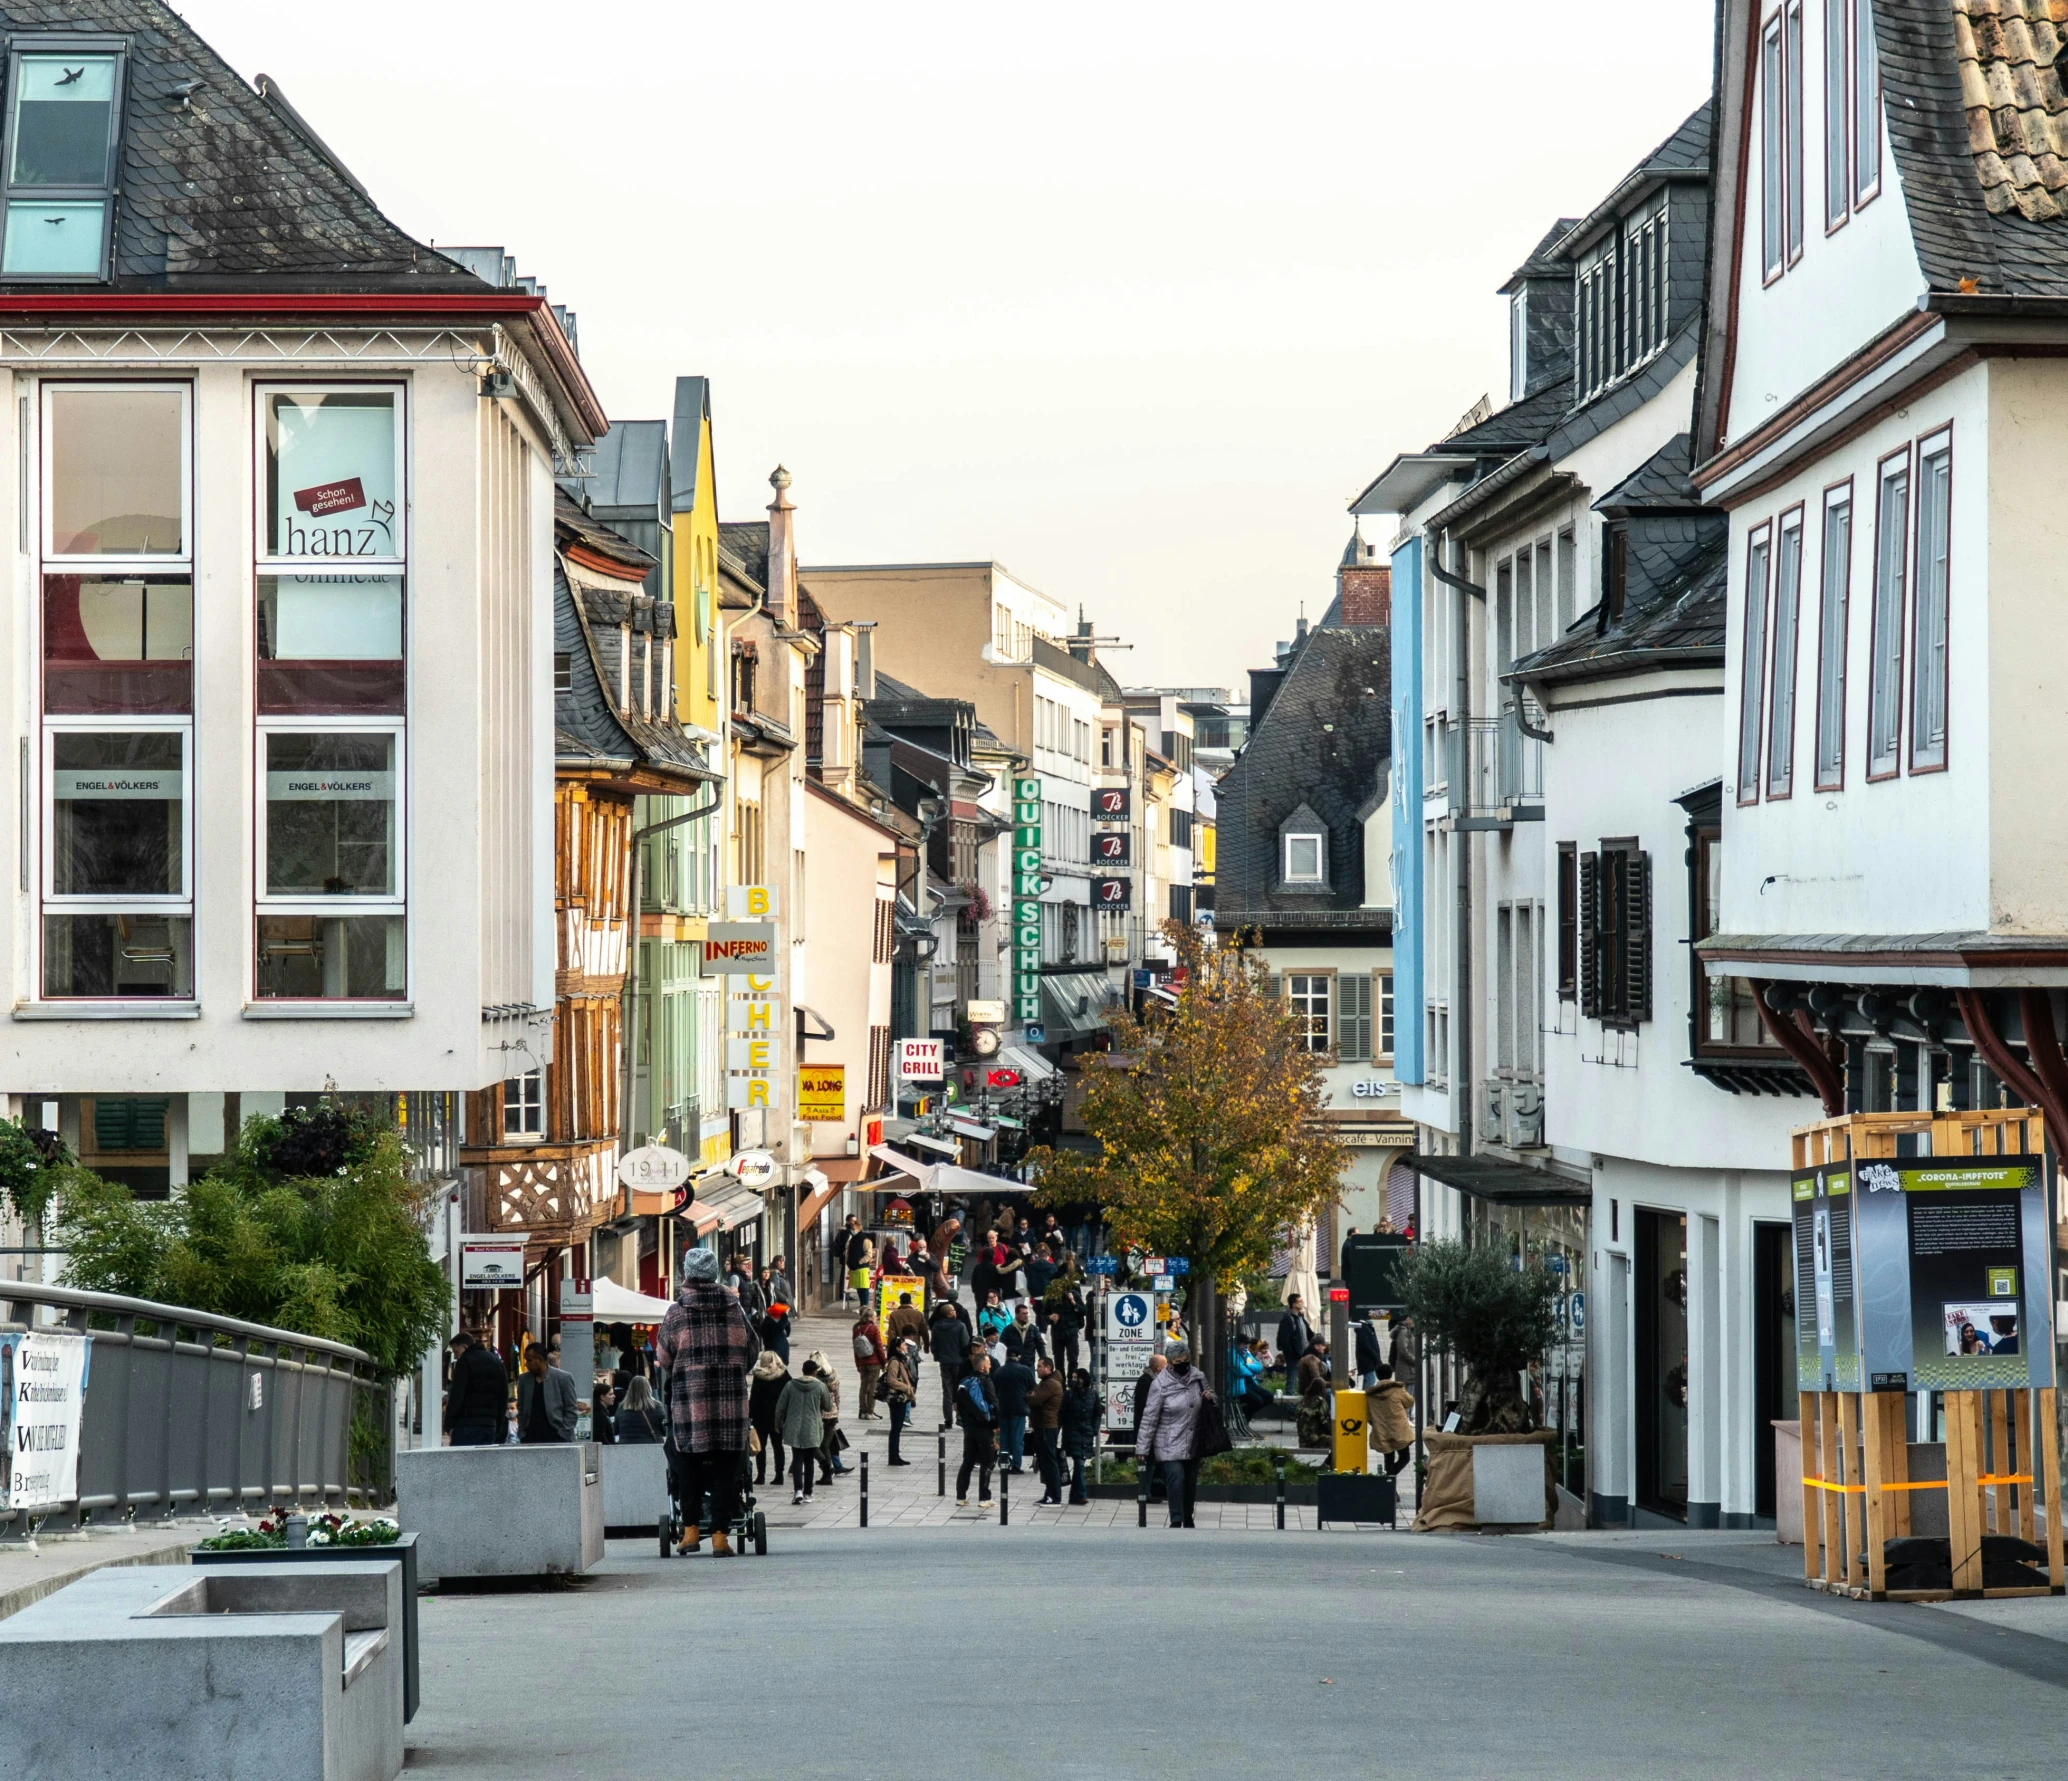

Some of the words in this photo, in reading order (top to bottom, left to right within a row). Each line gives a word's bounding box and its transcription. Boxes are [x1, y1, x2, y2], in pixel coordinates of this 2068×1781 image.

[316, 488, 346, 501] Schon
[312, 494, 355, 512] gesehen!
[285, 516, 376, 555] hanz
[706, 940, 768, 961] INFERNO
[747, 888, 772, 1106] BCHER
[906, 1044, 938, 1057] CITY
[902, 1061, 940, 1074] GRILL
[1353, 1077, 1386, 1097] eis
[1118, 1328, 1143, 1338] ZONE
[1115, 1361, 1146, 1369] werktags
